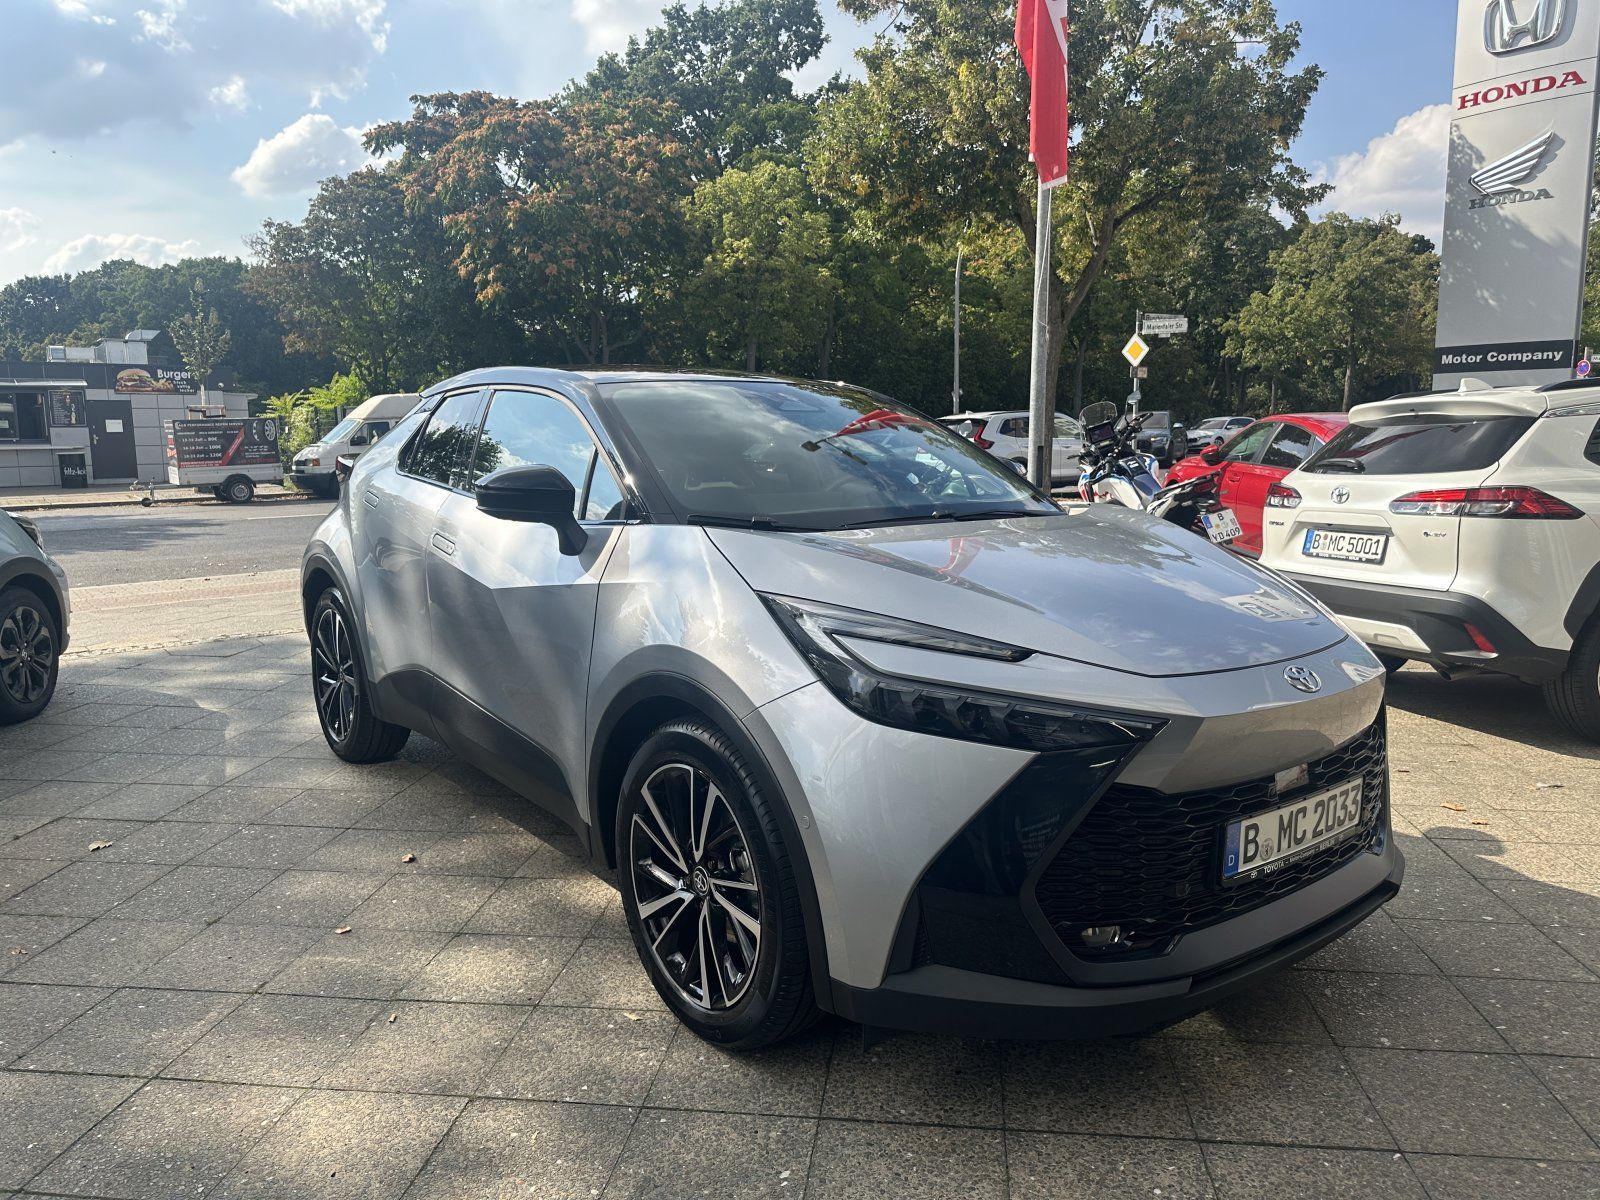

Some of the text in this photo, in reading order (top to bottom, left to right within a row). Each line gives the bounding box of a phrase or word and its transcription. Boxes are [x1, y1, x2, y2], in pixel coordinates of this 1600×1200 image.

[1457, 70, 1587, 110] HONDA
[1468, 188, 1555, 210] HONDA
[1441, 350, 1564, 365] Motor Company
[157, 369, 191, 380] Burger
[1217, 513, 1224, 521] B
[1312, 533, 1381, 556] B MC 5001
[1243, 785, 1361, 864] B MC 2033
[1228, 854, 1235, 866] D
[1263, 860, 1285, 874] TOYOTA
